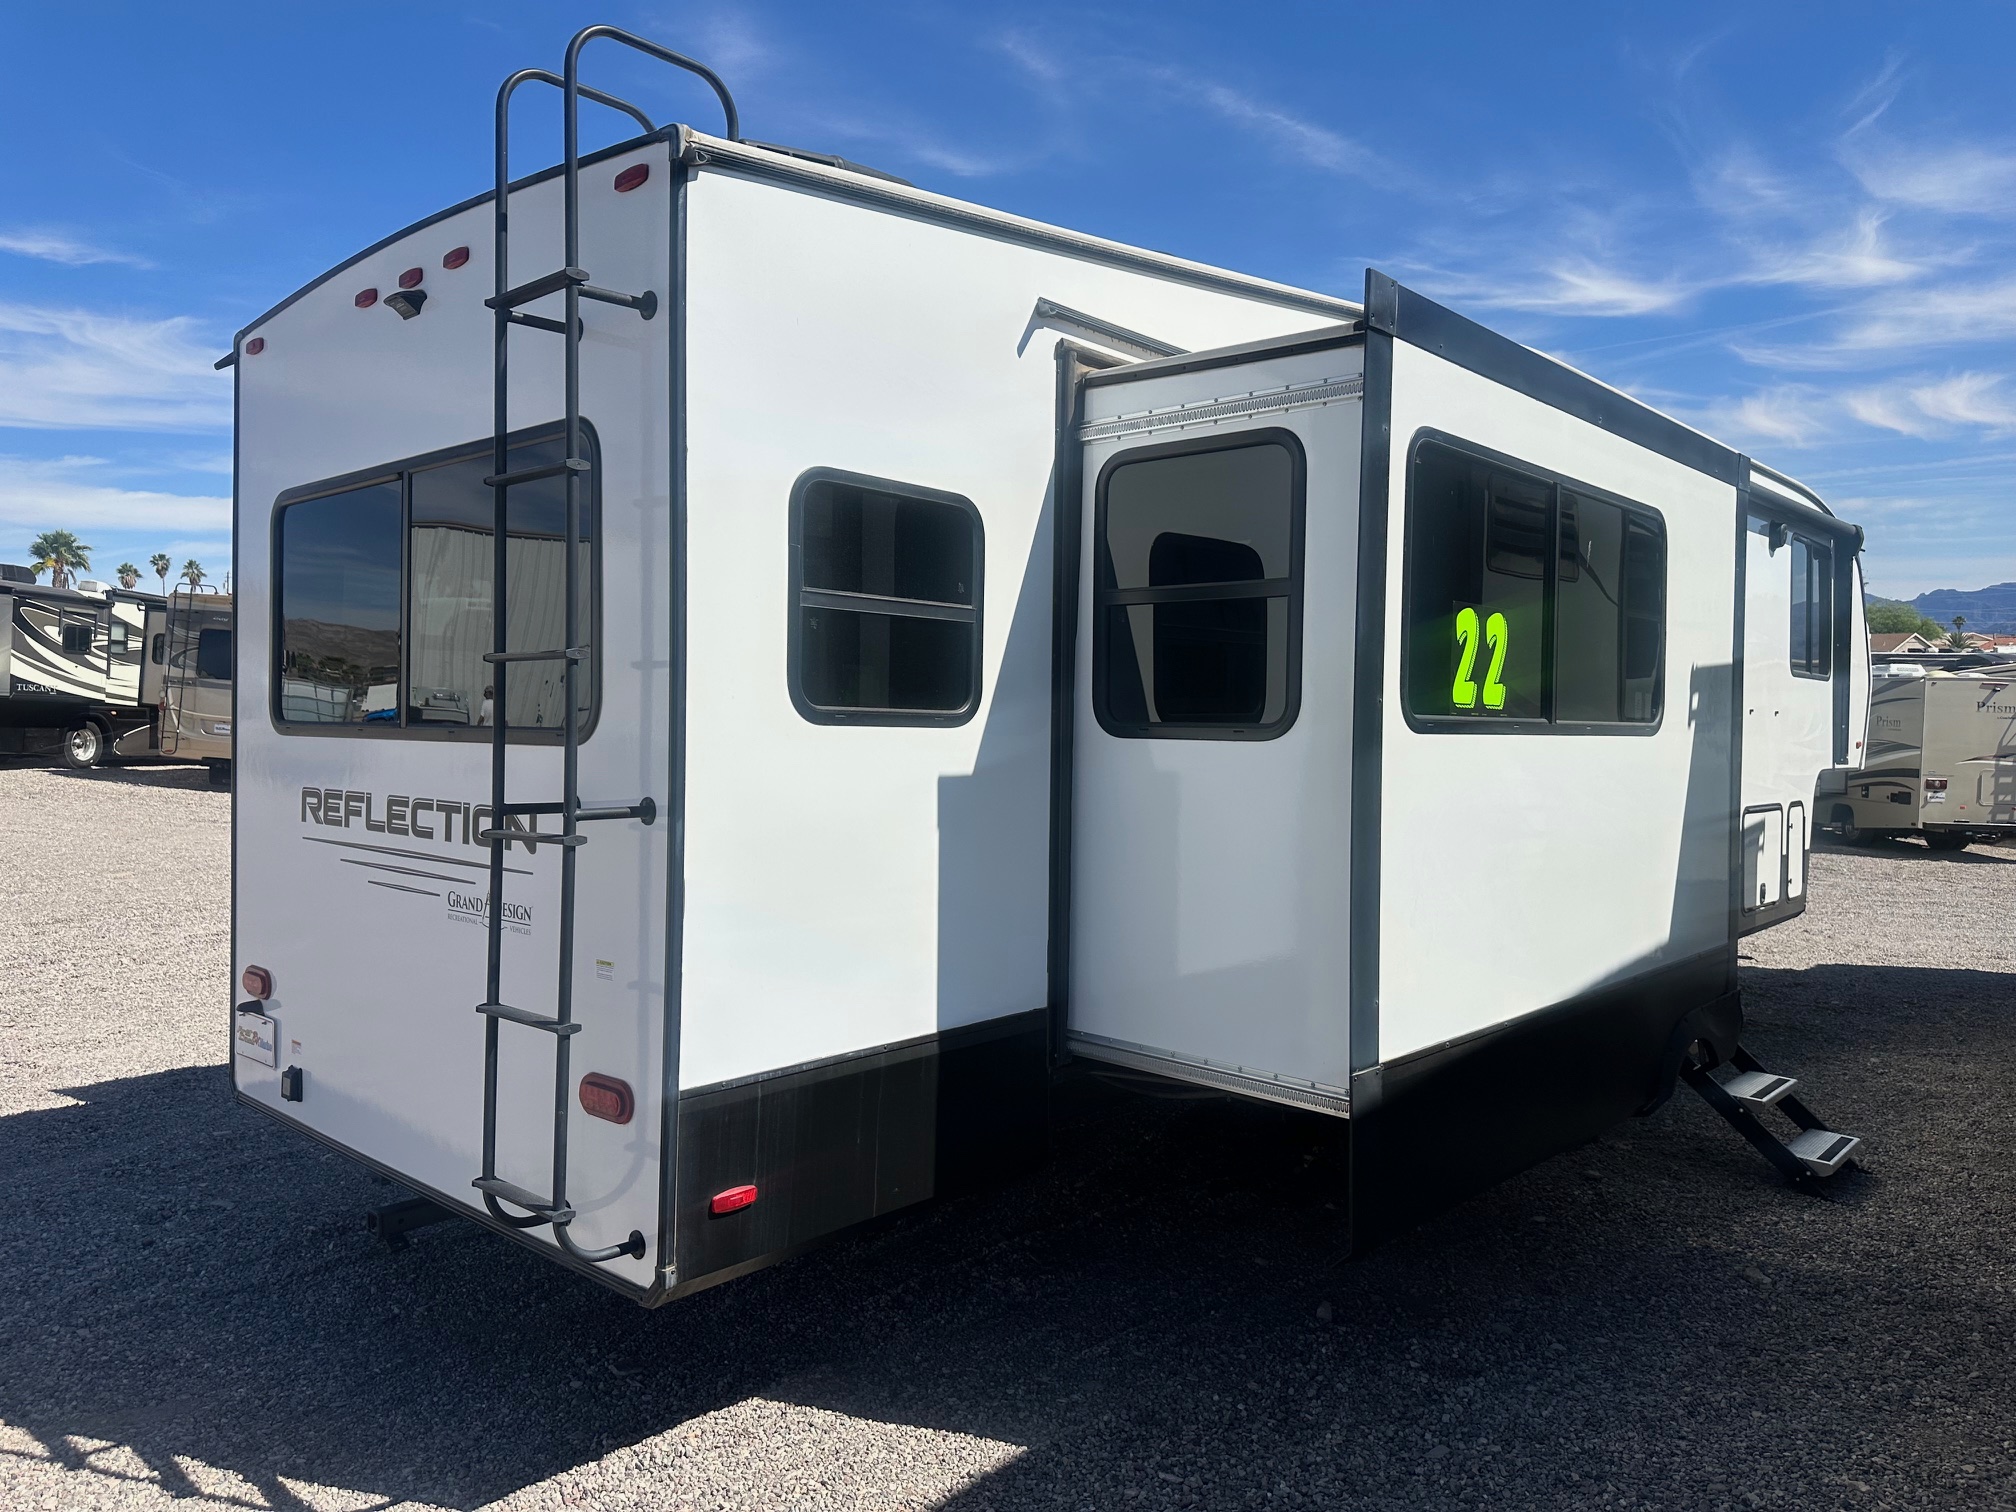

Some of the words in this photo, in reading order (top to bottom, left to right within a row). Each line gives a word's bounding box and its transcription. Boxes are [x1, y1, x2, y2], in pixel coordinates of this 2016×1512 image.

[1452, 607, 1508, 710] 22
[1976, 701, 2016, 714] Prism
[1876, 715, 1901, 728] Prism
[447, 890, 483, 913] GRAND
[499, 902, 532, 922] ESIGN
[509, 925, 532, 936] VEHICLES
